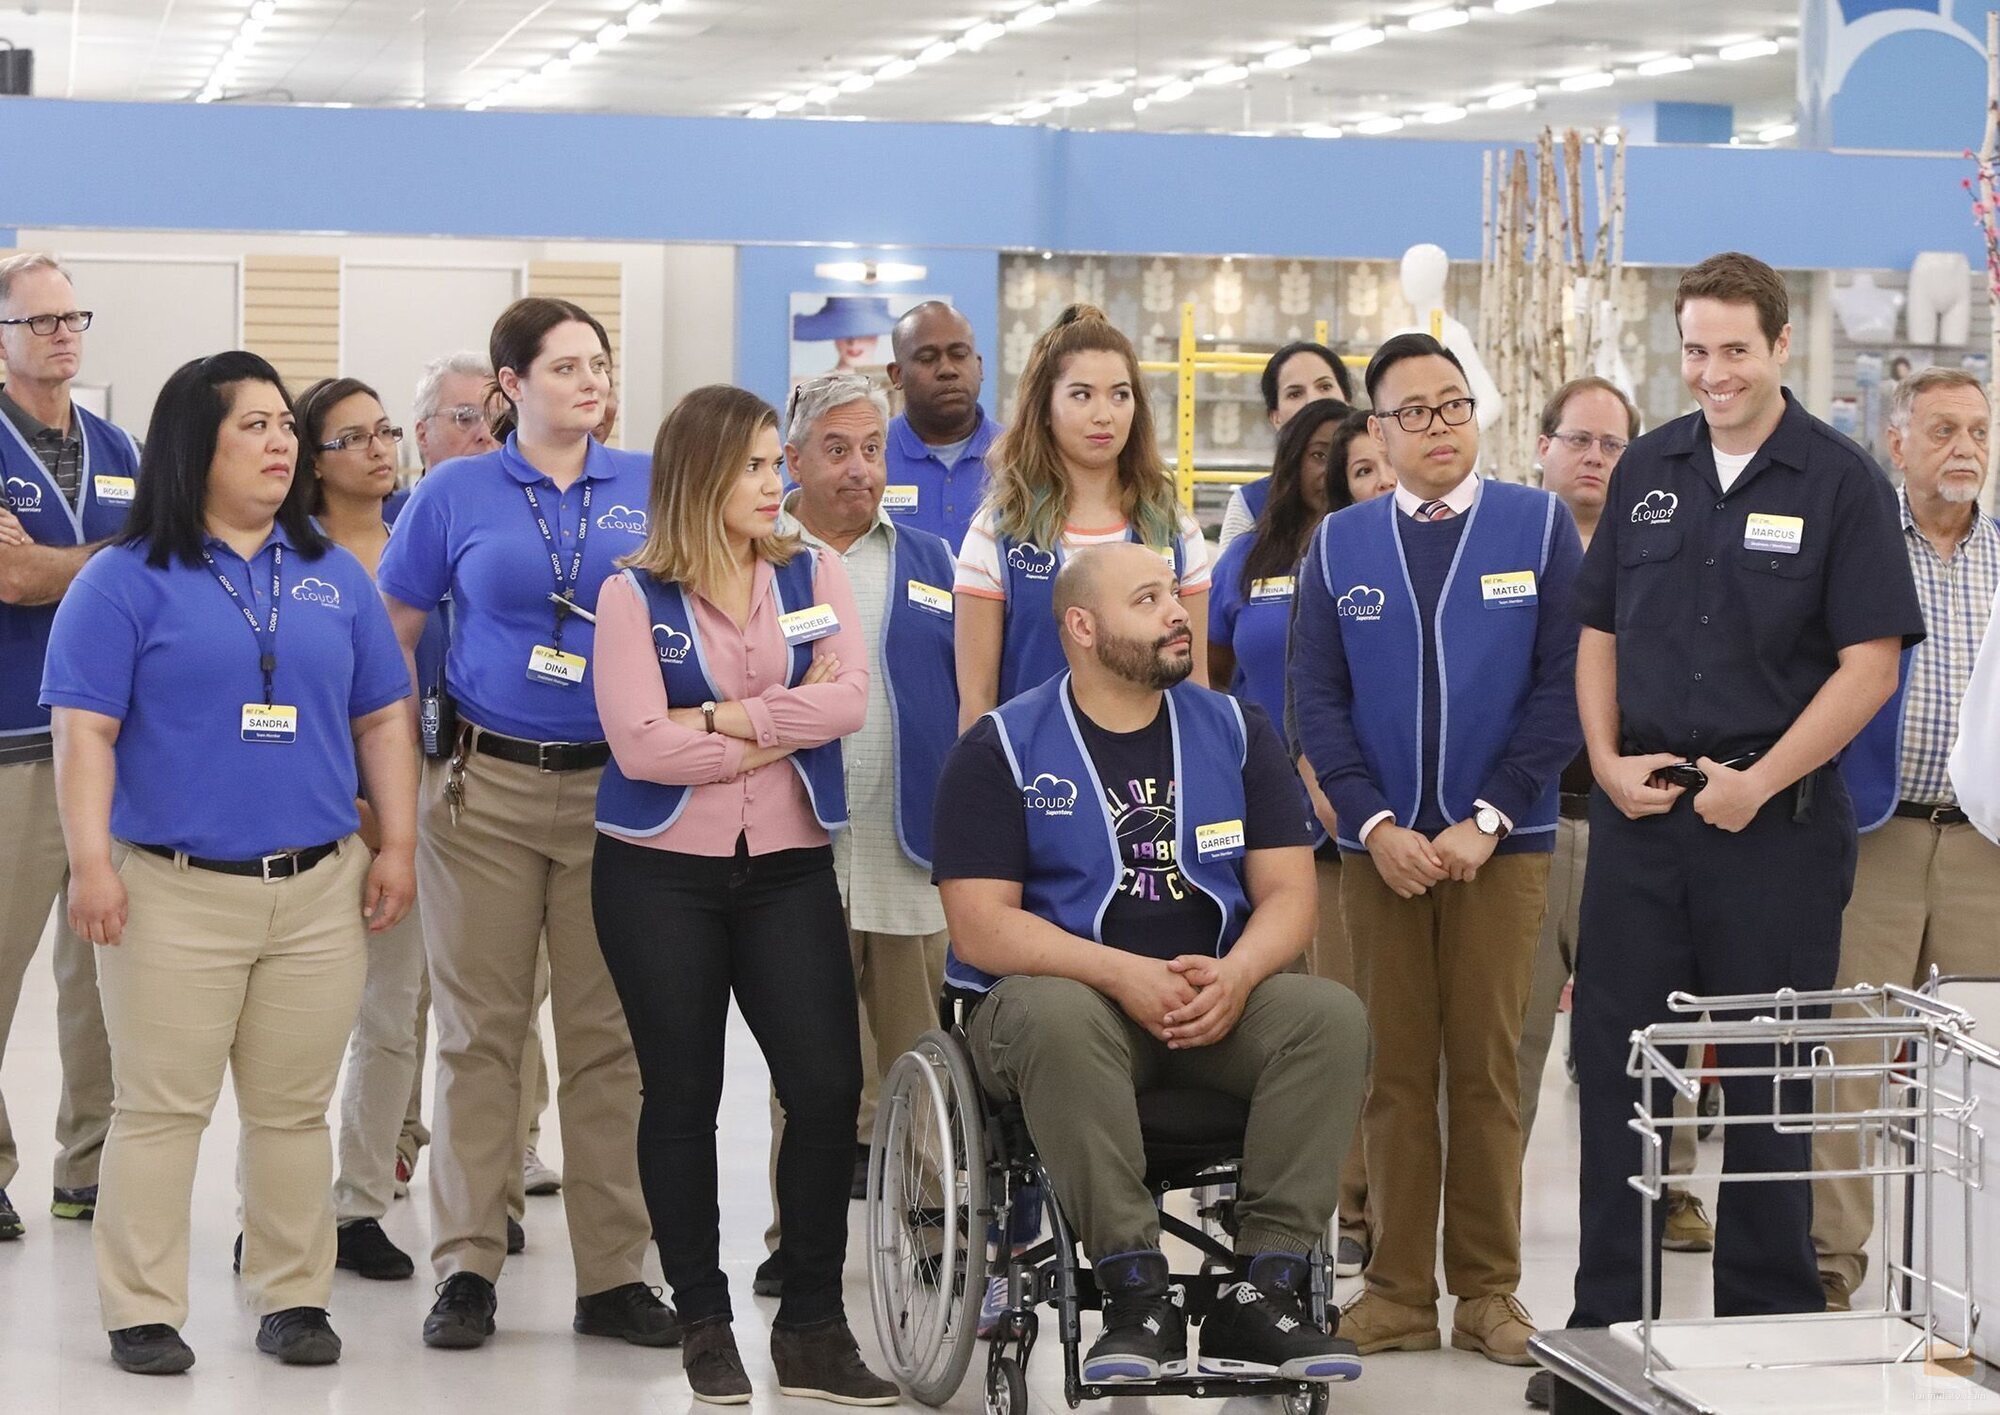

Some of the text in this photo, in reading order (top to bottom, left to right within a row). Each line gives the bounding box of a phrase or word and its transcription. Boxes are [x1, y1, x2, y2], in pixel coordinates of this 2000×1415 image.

[1631, 508, 1674, 523] CLOUD9
[1751, 527, 1796, 540] MARCUS
[551, 553, 562, 575] CLOUD
[570, 558, 581, 580] CLOUD
[1492, 585, 1527, 596] MATEO
[922, 596, 938, 605] JAY
[243, 608, 258, 627] CLOUD
[1337, 605, 1382, 616] CLOUD9
[269, 612, 279, 632] CLOUD
[789, 616, 831, 633] PHOEBE
[544, 662, 568, 676] DINA
[249, 718, 289, 728] SANDRA
[1128, 778, 1156, 804] OF
[1201, 834, 1241, 849] GARRETT
